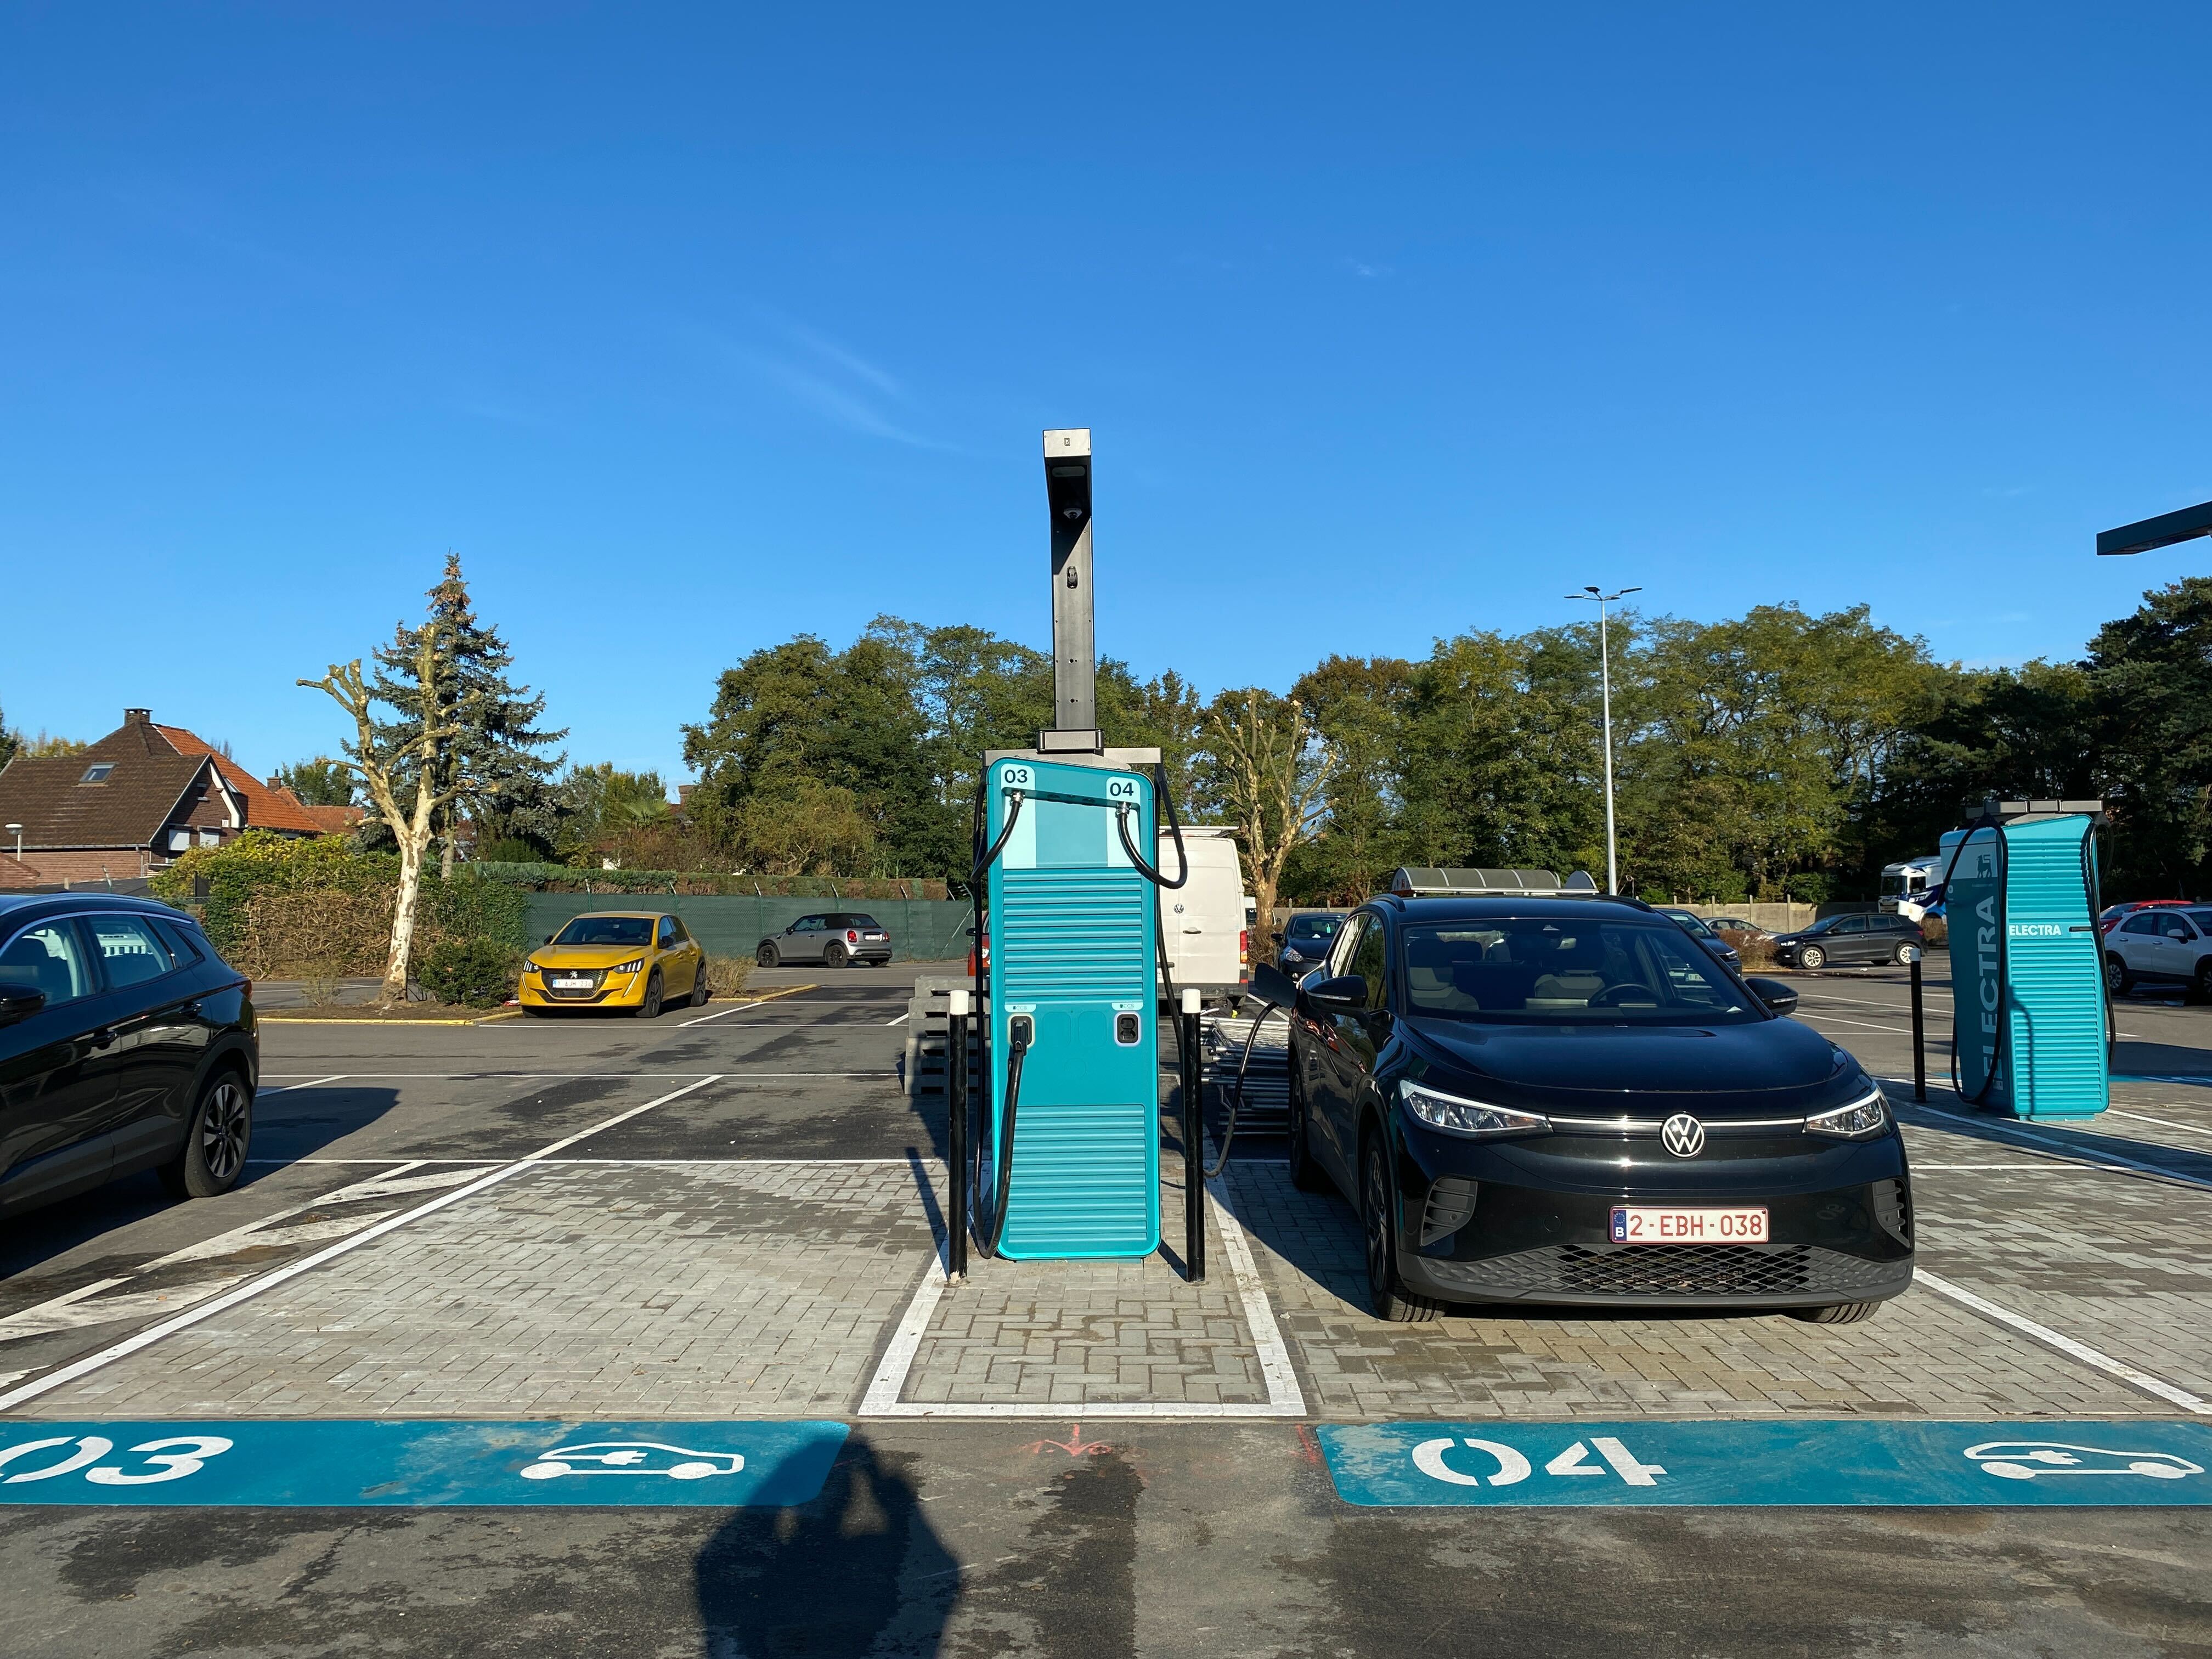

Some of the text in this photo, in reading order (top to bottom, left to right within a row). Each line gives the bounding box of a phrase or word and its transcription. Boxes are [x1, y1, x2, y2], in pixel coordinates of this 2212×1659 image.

[1004, 769, 1028, 783] 03
[1109, 782, 1134, 797] 04
[2008, 924, 2062, 936] ELECTRA
[1615, 1227, 1624, 1237] B
[1630, 1214, 1762, 1237] 2-EBH-038
[0, 1436, 233, 1485] 03
[1412, 1437, 1668, 1486] 04
